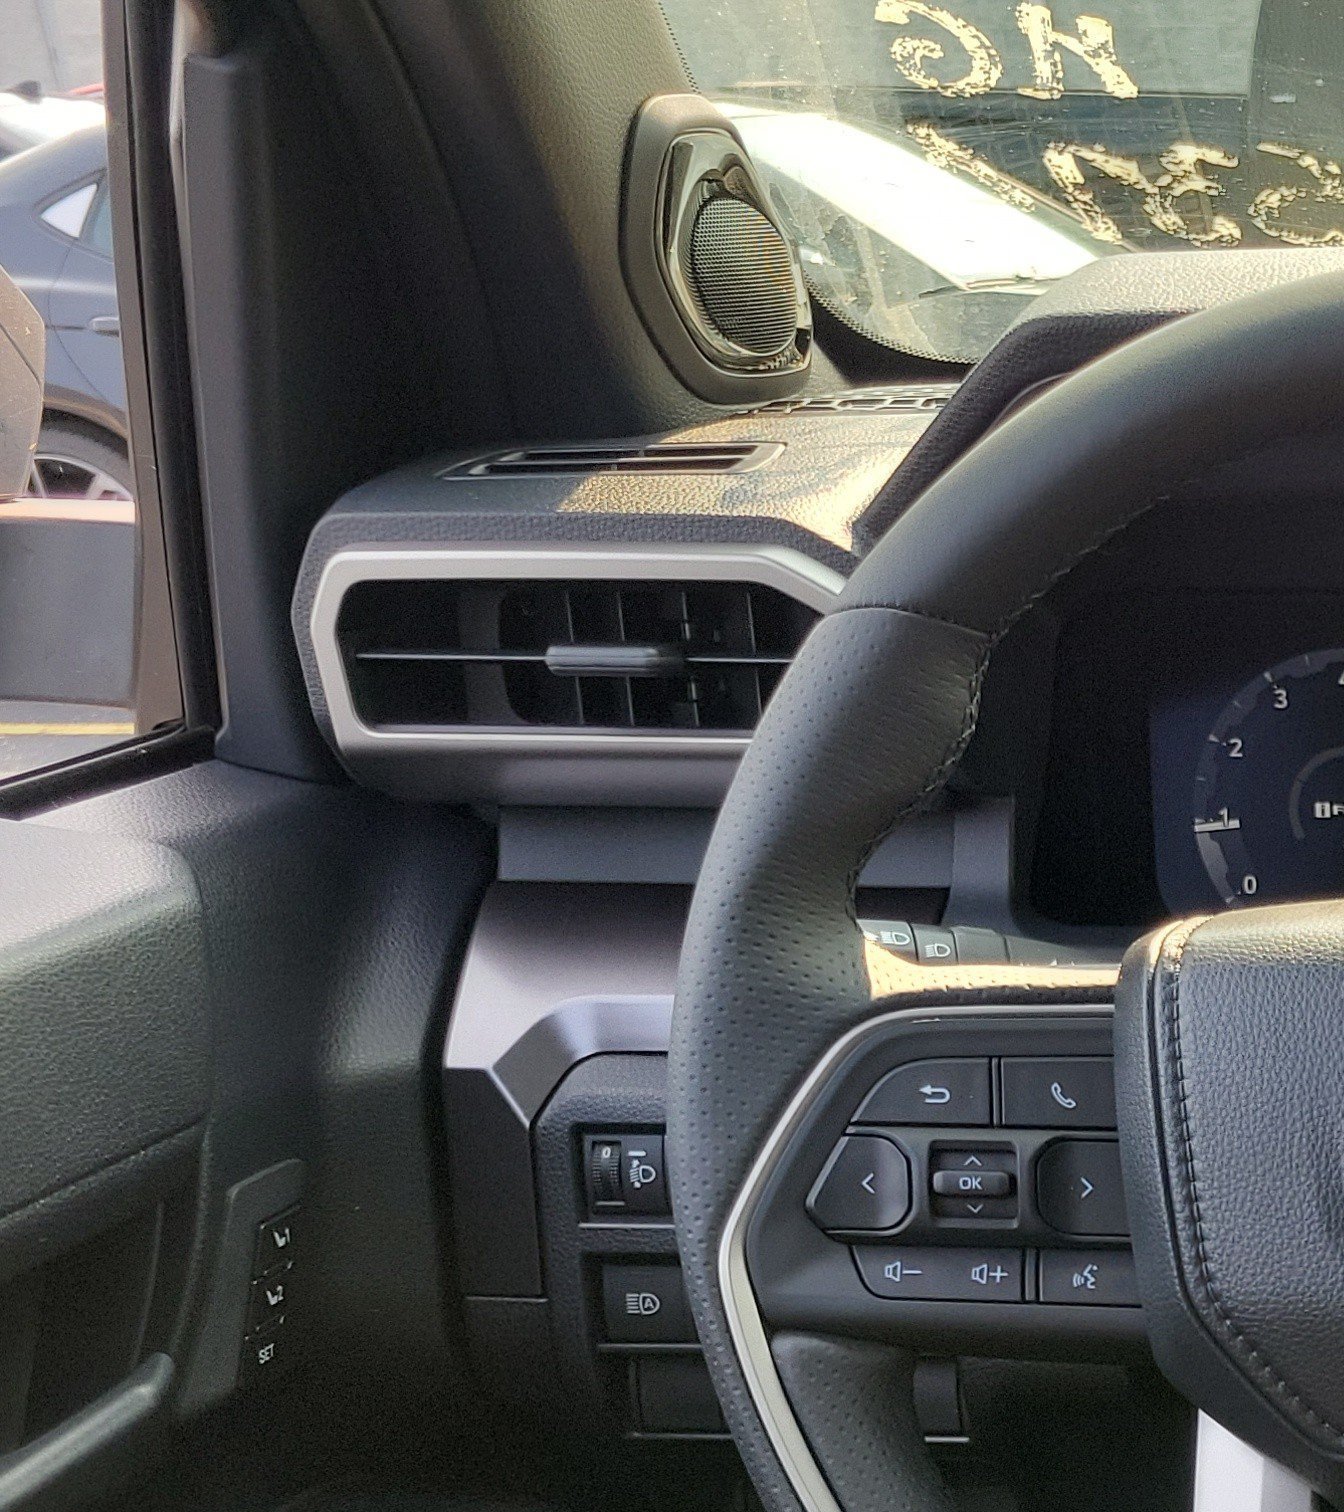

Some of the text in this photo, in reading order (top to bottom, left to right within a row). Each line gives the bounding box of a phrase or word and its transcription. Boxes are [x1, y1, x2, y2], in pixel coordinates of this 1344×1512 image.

[1273, 689, 1289, 709] 3
[1228, 739, 1243, 758] 2
[1218, 808, 1229, 826] 1
[1243, 876, 1258, 895] 0
[958, 1176, 983, 1190] OK
[258, 1343, 275, 1364] SET
